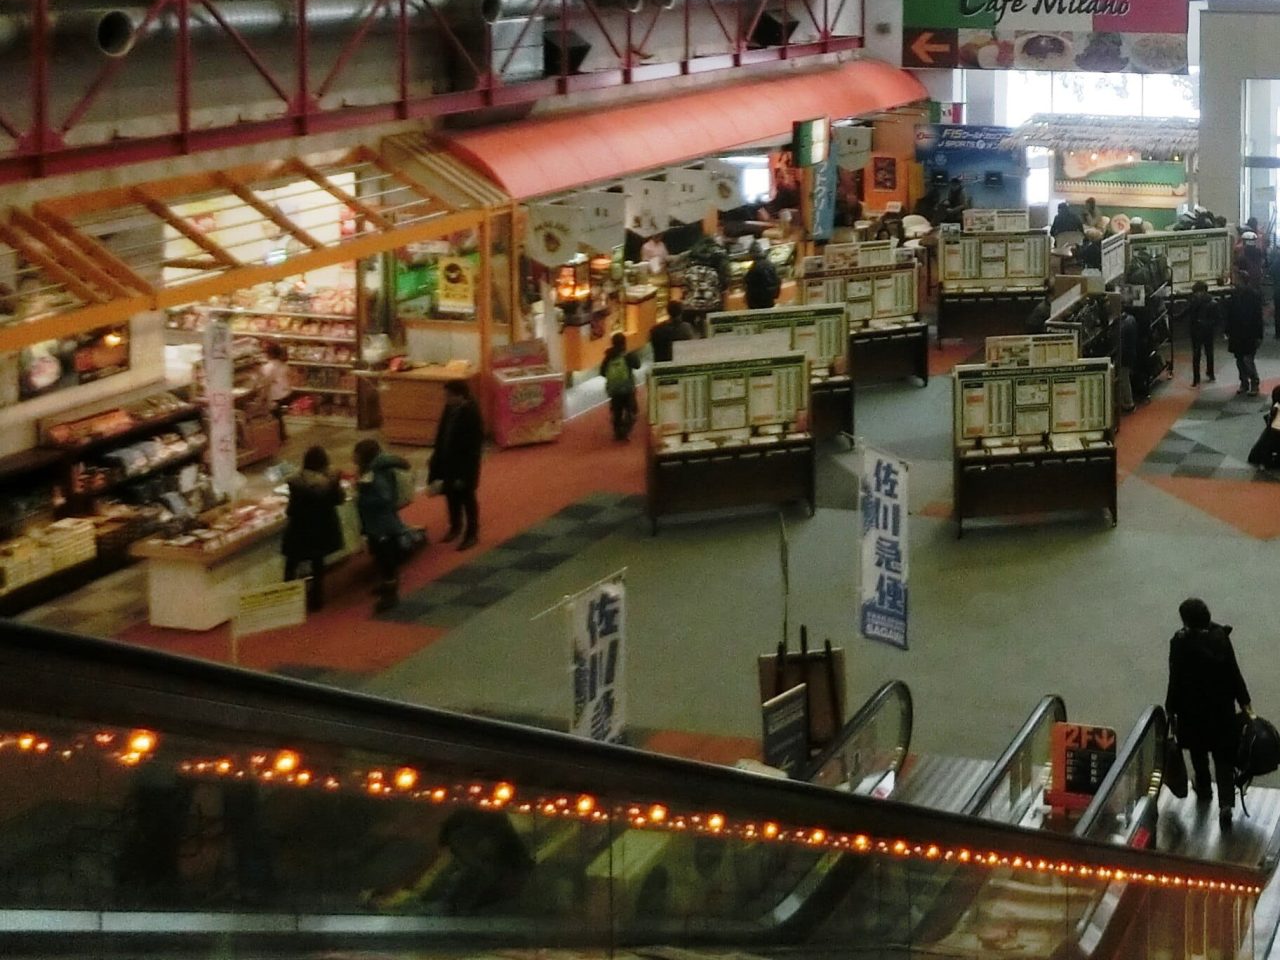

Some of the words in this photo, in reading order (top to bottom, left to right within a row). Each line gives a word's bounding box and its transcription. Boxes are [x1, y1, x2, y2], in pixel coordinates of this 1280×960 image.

[875, 458, 904, 615] 佐川急便
[587, 592, 620, 743] 佐川急
[1065, 726, 1094, 749] 2F
